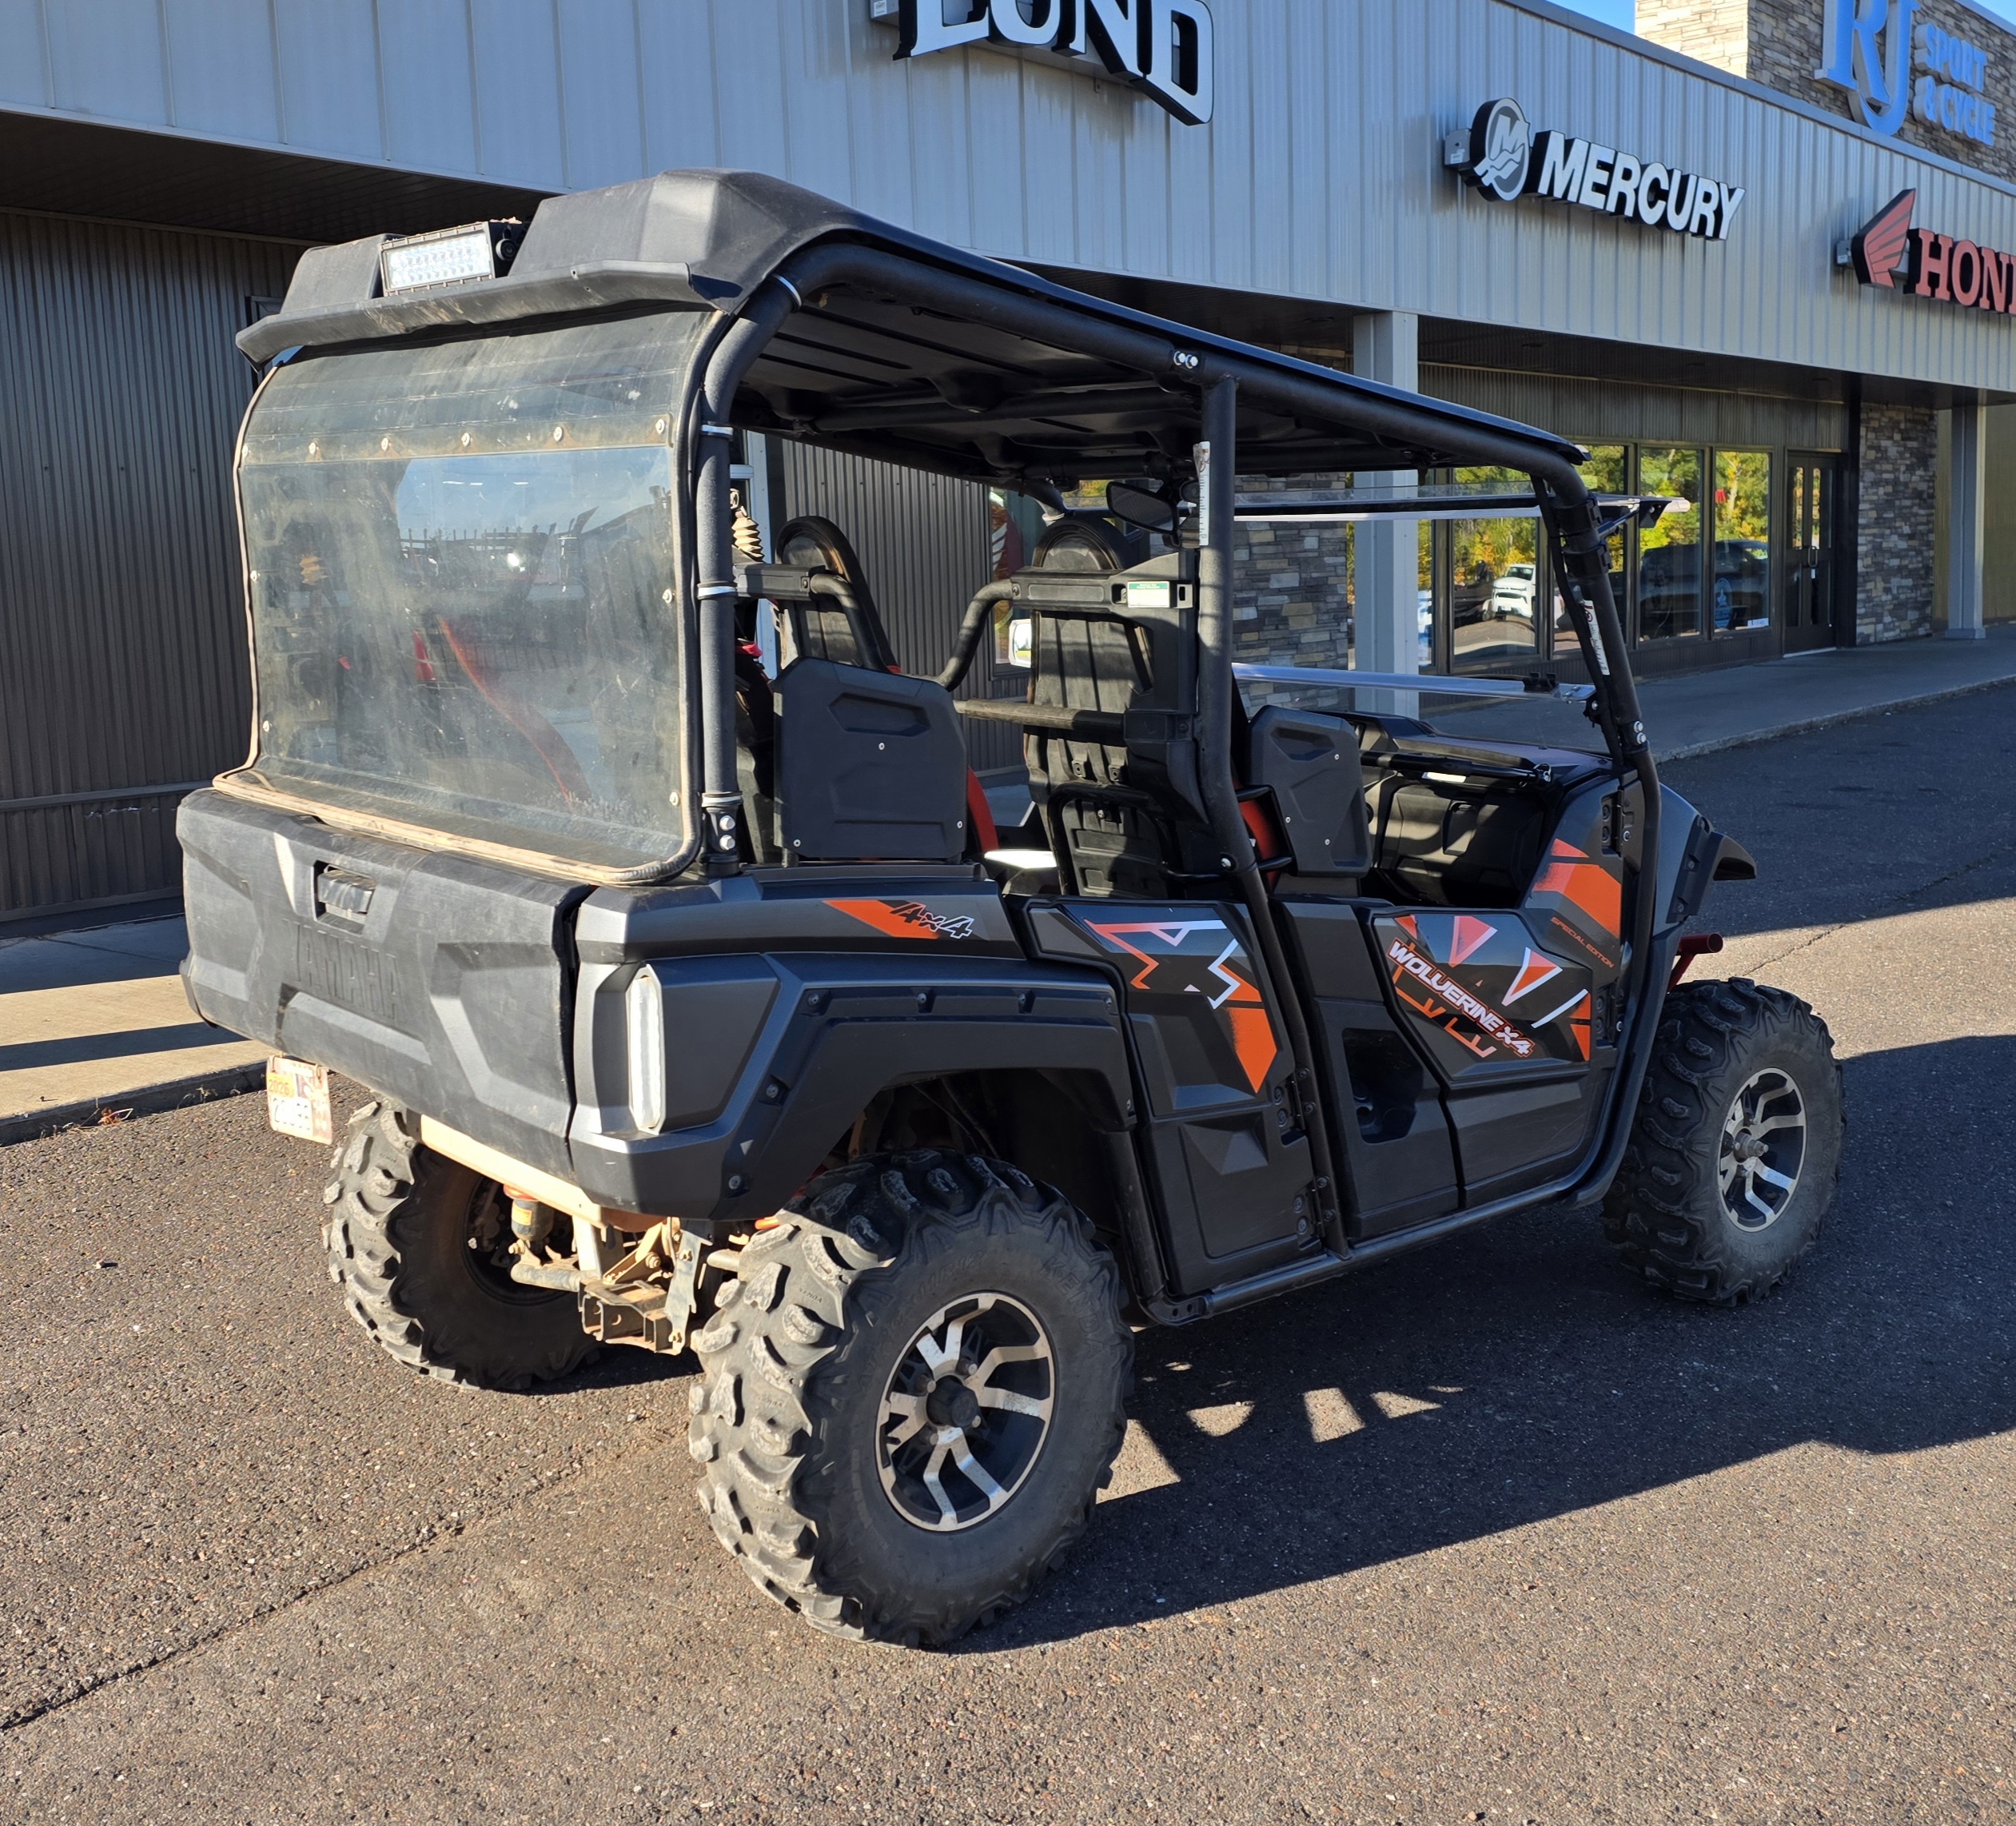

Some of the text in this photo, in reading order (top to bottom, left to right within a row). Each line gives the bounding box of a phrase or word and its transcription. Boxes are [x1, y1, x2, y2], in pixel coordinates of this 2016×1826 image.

[1821, 0, 1921, 135] RJ
[1920, 23, 1987, 92] SPORT
[1919, 75, 1995, 146] & CYCLE
[1536, 130, 1746, 241] MERCURY
[1914, 228, 2016, 316] HON
[281, 918, 406, 1022] YAMAHA
[1551, 916, 1615, 969] SPECIAL EDITION
[1388, 939, 1536, 1058] WOLVERINE X4
[1038, 1255, 1105, 1362] KENDA
